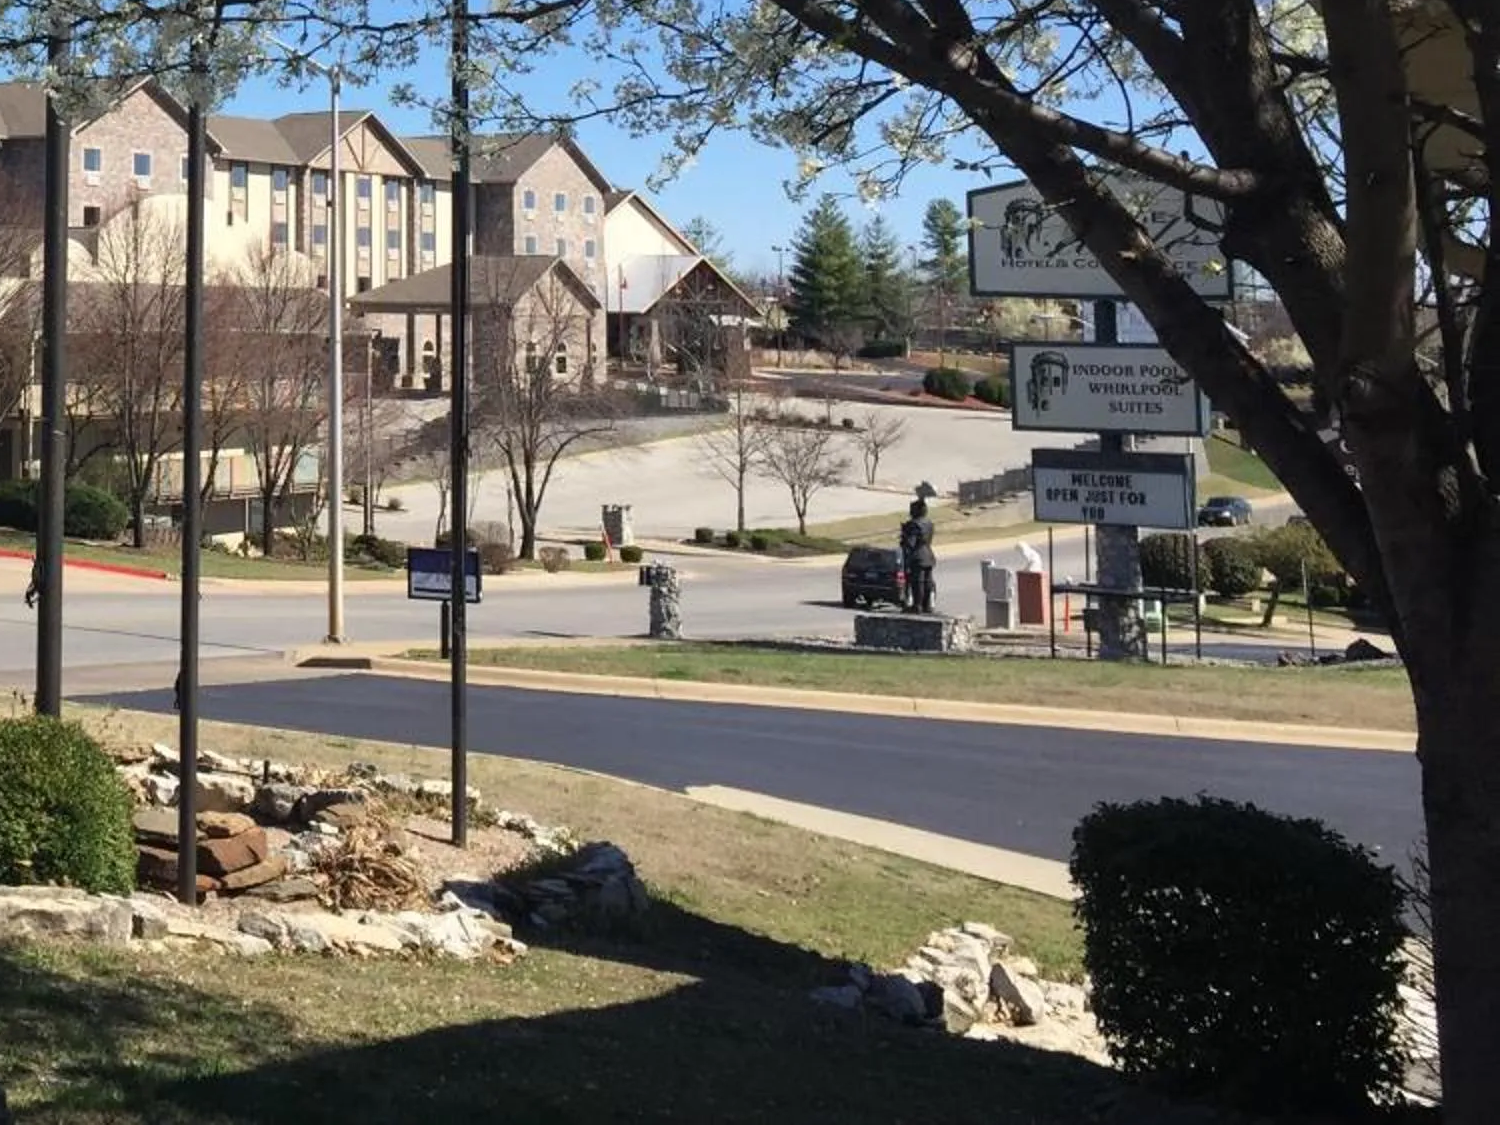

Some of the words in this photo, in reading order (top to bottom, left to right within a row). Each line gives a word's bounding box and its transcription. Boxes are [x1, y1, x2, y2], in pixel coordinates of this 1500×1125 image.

[1072, 364, 1135, 377] INDOOR
[1089, 382, 1184, 397] WHIRLPOOL
[1108, 400, 1164, 415] SUITES
[1072, 473, 1133, 489] WELCOME
[1046, 488, 1079, 503] OPEN
[1084, 490, 1115, 505] JUST
[1119, 492, 1148, 506] FOR
[1082, 506, 1105, 521] YOU
